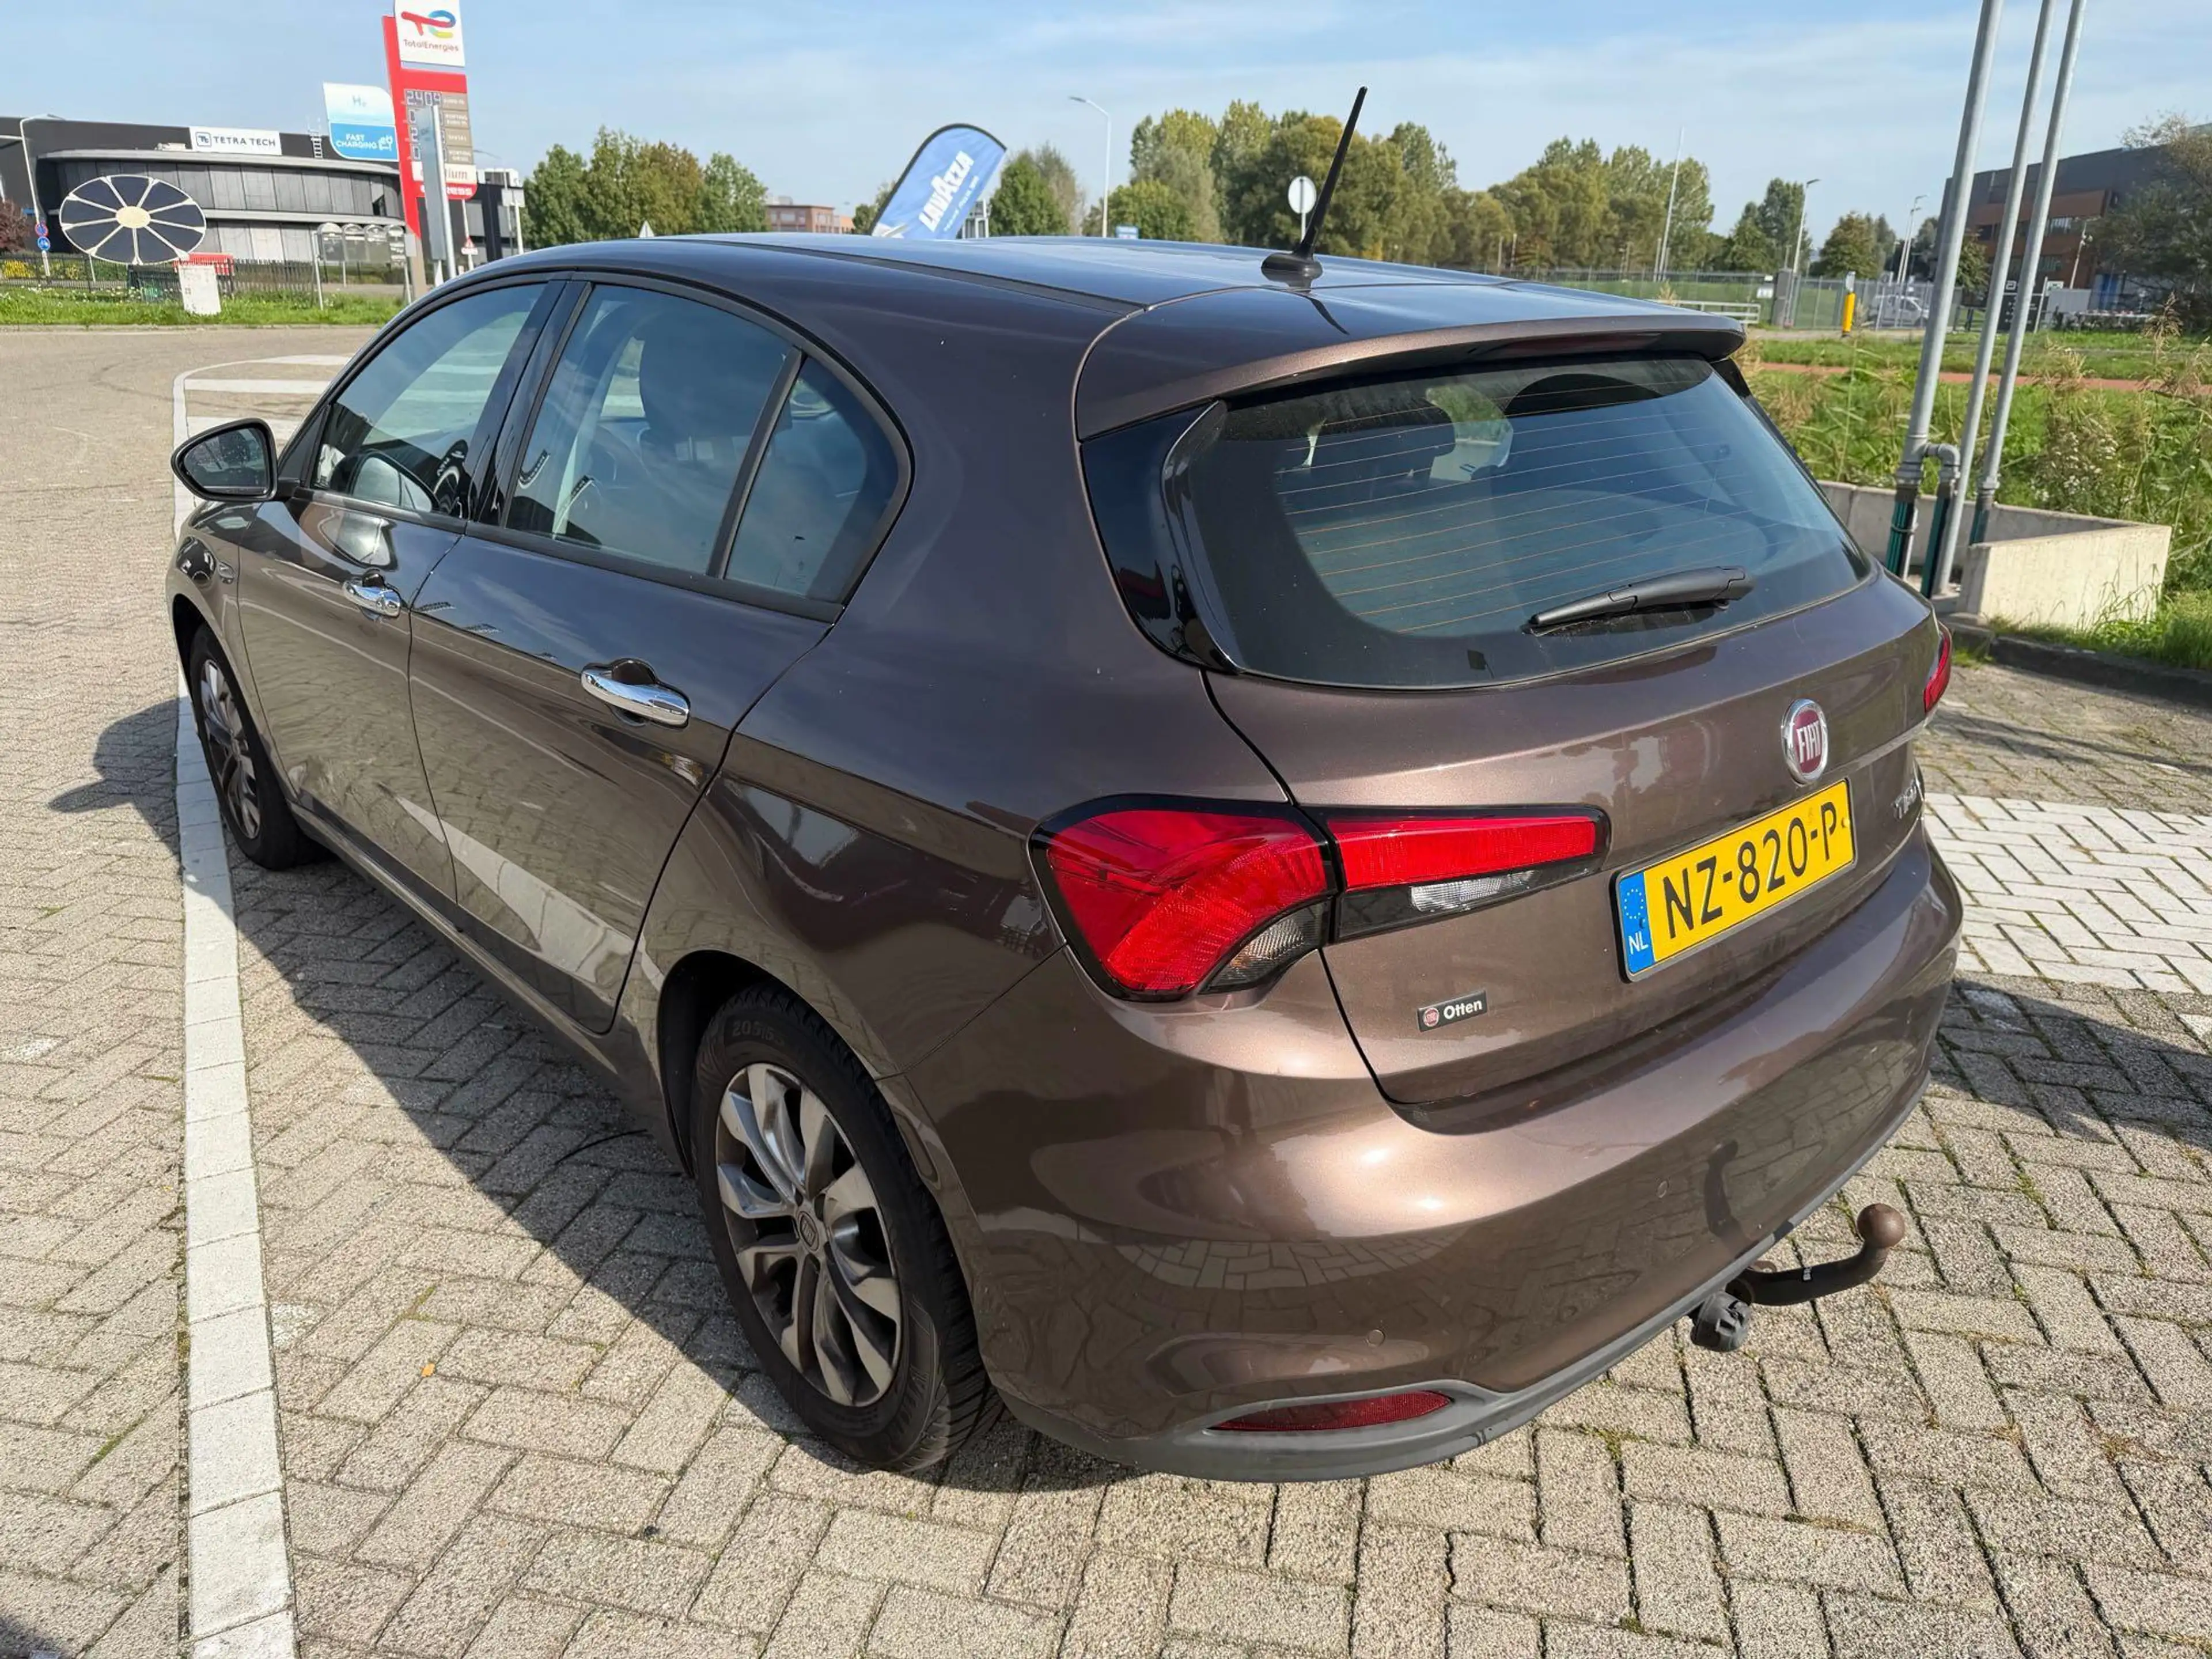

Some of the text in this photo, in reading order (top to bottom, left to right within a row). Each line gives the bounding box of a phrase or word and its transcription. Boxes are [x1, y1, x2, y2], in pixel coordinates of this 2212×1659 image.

[403, 39, 459, 52] TotalEnergies
[213, 135, 247, 145] TETRA
[249, 138, 275, 146] TECH
[336, 140, 377, 150] CHARGING
[346, 133, 365, 142] FAST
[918, 150, 975, 233] LAVAZZA
[1796, 721, 1821, 764] FIAT
[1663, 801, 1838, 940] NZ-820-P
[1627, 930, 1649, 955] NL
[1444, 1000, 1482, 1020] Otten
